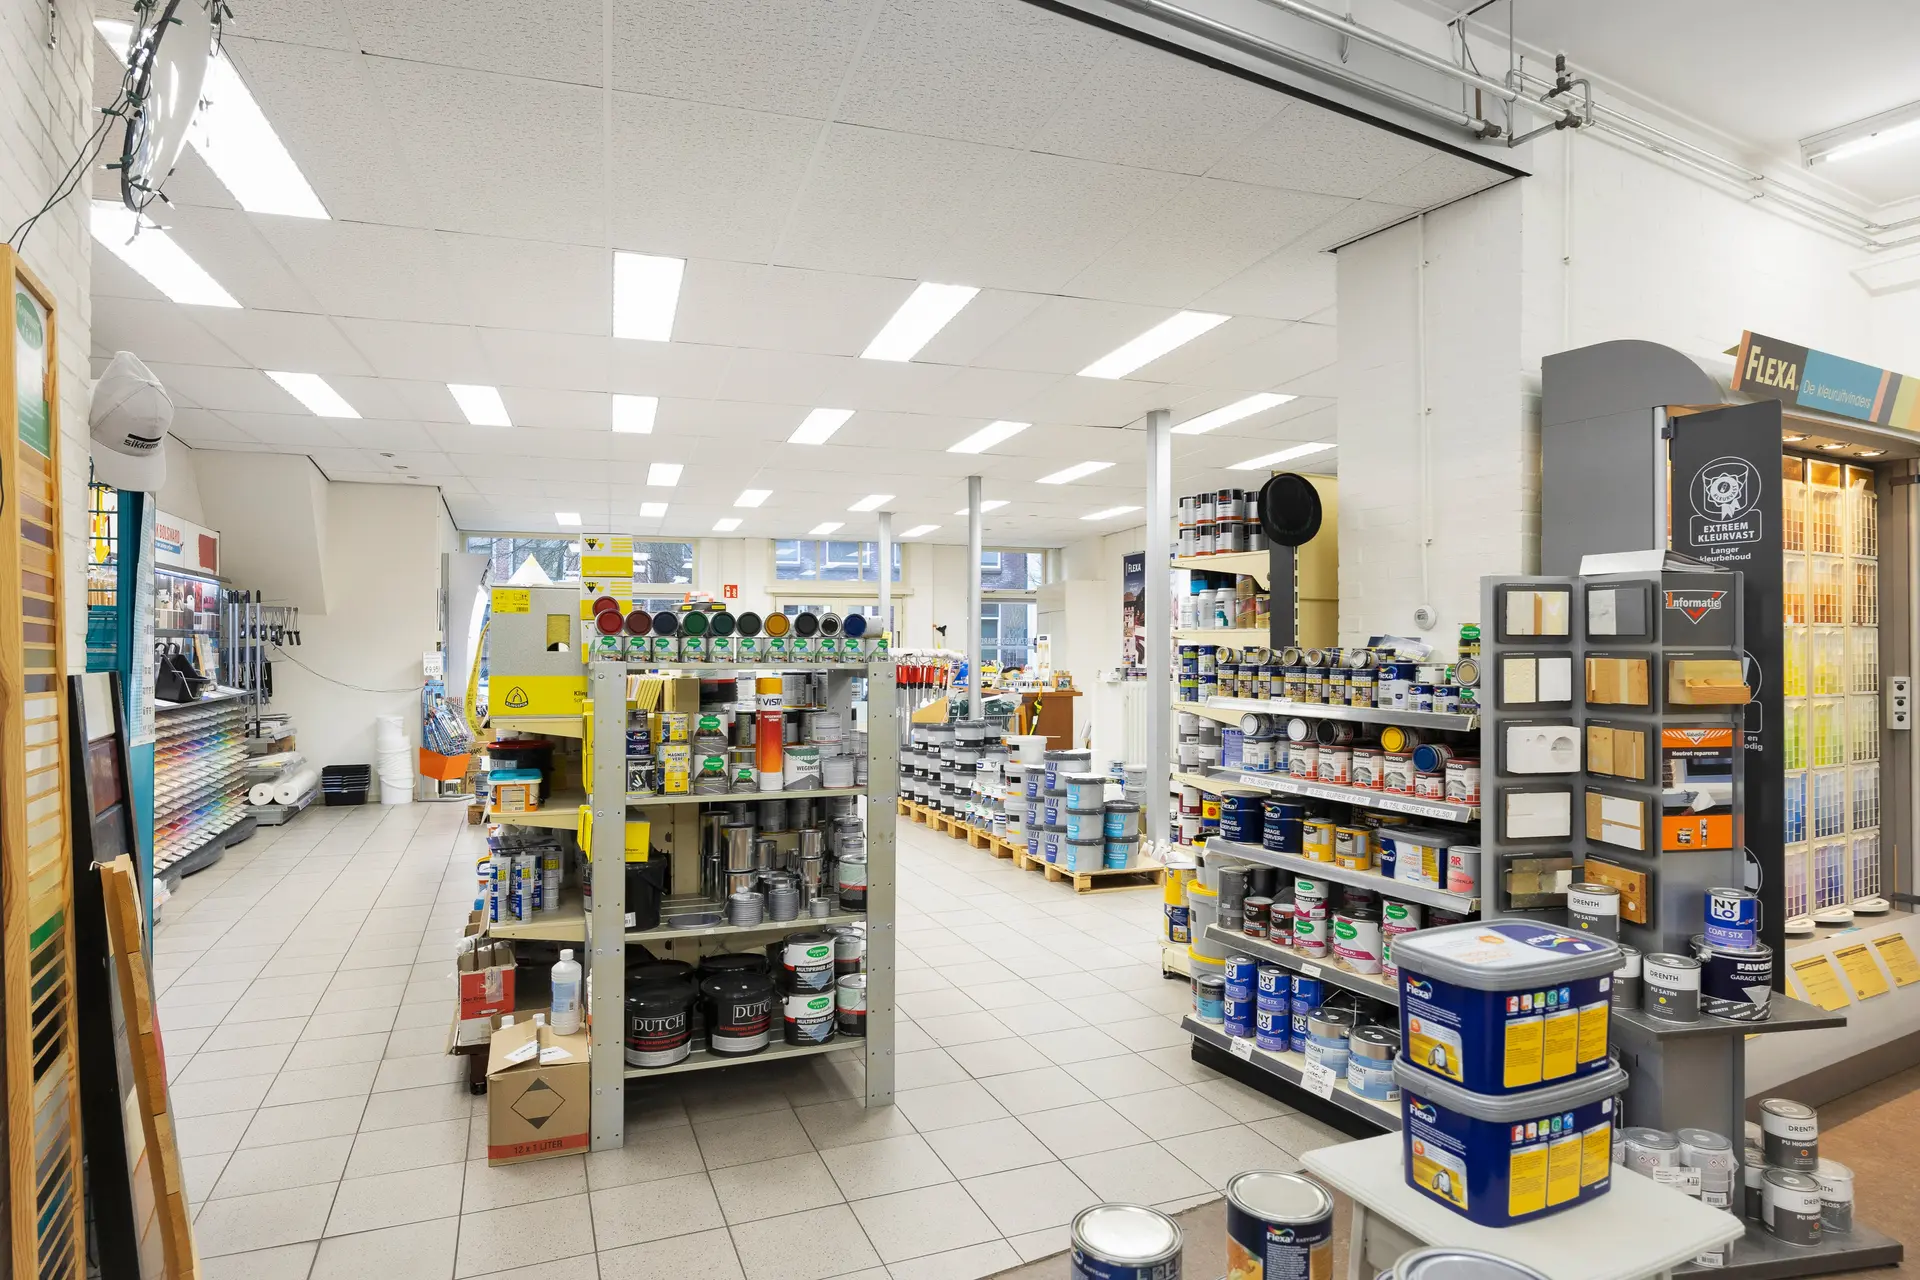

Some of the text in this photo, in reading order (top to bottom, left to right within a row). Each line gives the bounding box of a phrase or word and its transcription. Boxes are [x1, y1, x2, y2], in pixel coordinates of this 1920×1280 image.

[1745, 345, 1796, 391] FLEXA
[1803, 380, 1815, 395] De
[1713, 485, 1737, 501] KLEURVAST
[1703, 522, 1748, 533] EXTREEM
[1698, 530, 1755, 542] KLEURVAST
[1699, 553, 1752, 562] kleurbehoud
[1667, 592, 1720, 608] Informatie
[1744, 743, 1763, 751] odig
[1326, 791, 1347, 800] SUPER
[1401, 804, 1425, 814] SUPER
[1573, 898, 1600, 907] DRENTH
[1714, 899, 1737, 910] NY
[1715, 908, 1735, 919] LO
[1708, 927, 1744, 939] COAT STX
[1649, 971, 1679, 981] DRENTH
[1730, 974, 1757, 982] GARAGE
[1406, 982, 1429, 999] Flexa
[1658, 988, 1677, 997] SATIN
[735, 1000, 770, 1018] DUTC
[634, 1014, 684, 1031] DUTCH
[1258, 1014, 1269, 1022] NY
[1409, 1103, 1433, 1123] Flexa
[514, 1146, 524, 1154] 12
[540, 1139, 563, 1150] LITER
[1266, 1232, 1322, 1243] Flexa EASYCARE
